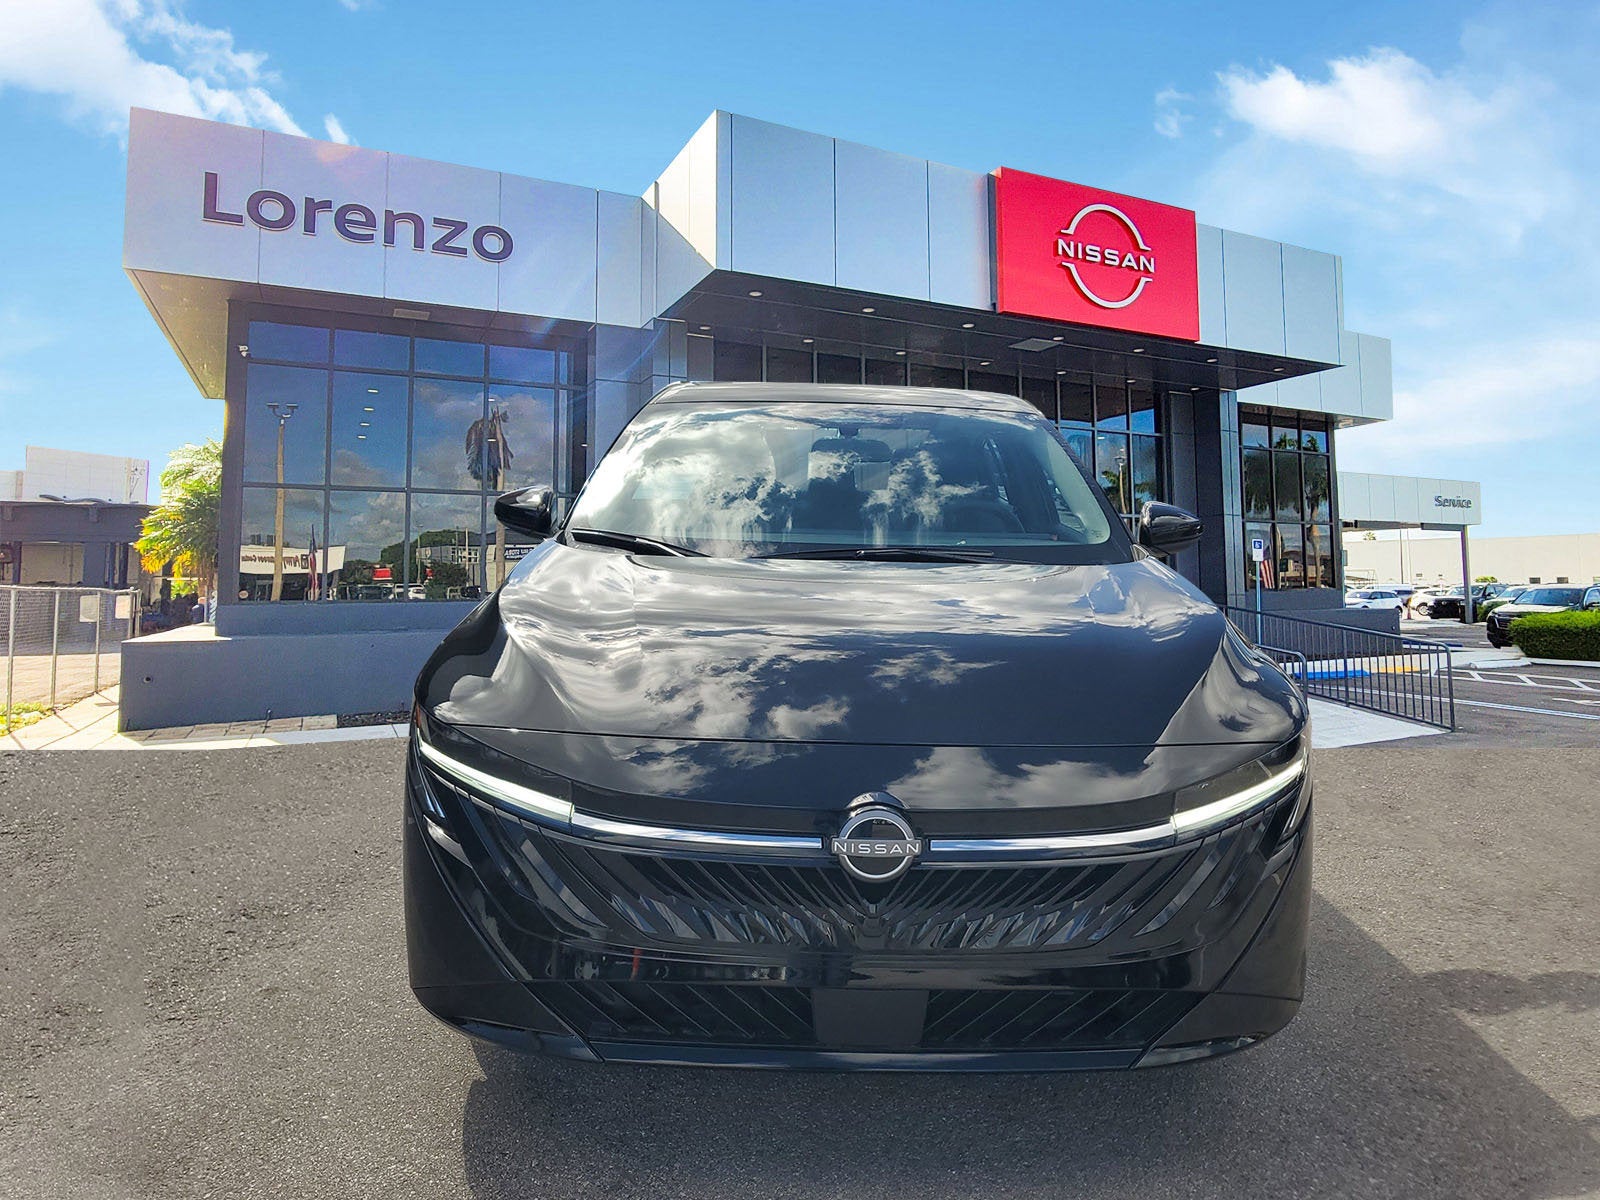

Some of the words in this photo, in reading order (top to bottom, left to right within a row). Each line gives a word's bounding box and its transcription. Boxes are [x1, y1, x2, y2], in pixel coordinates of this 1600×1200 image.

[202, 171, 514, 262] Lorenzo
[1057, 238, 1155, 273] NISSAN
[1434, 495, 1472, 509] Service
[833, 842, 919, 854] NISSAN
